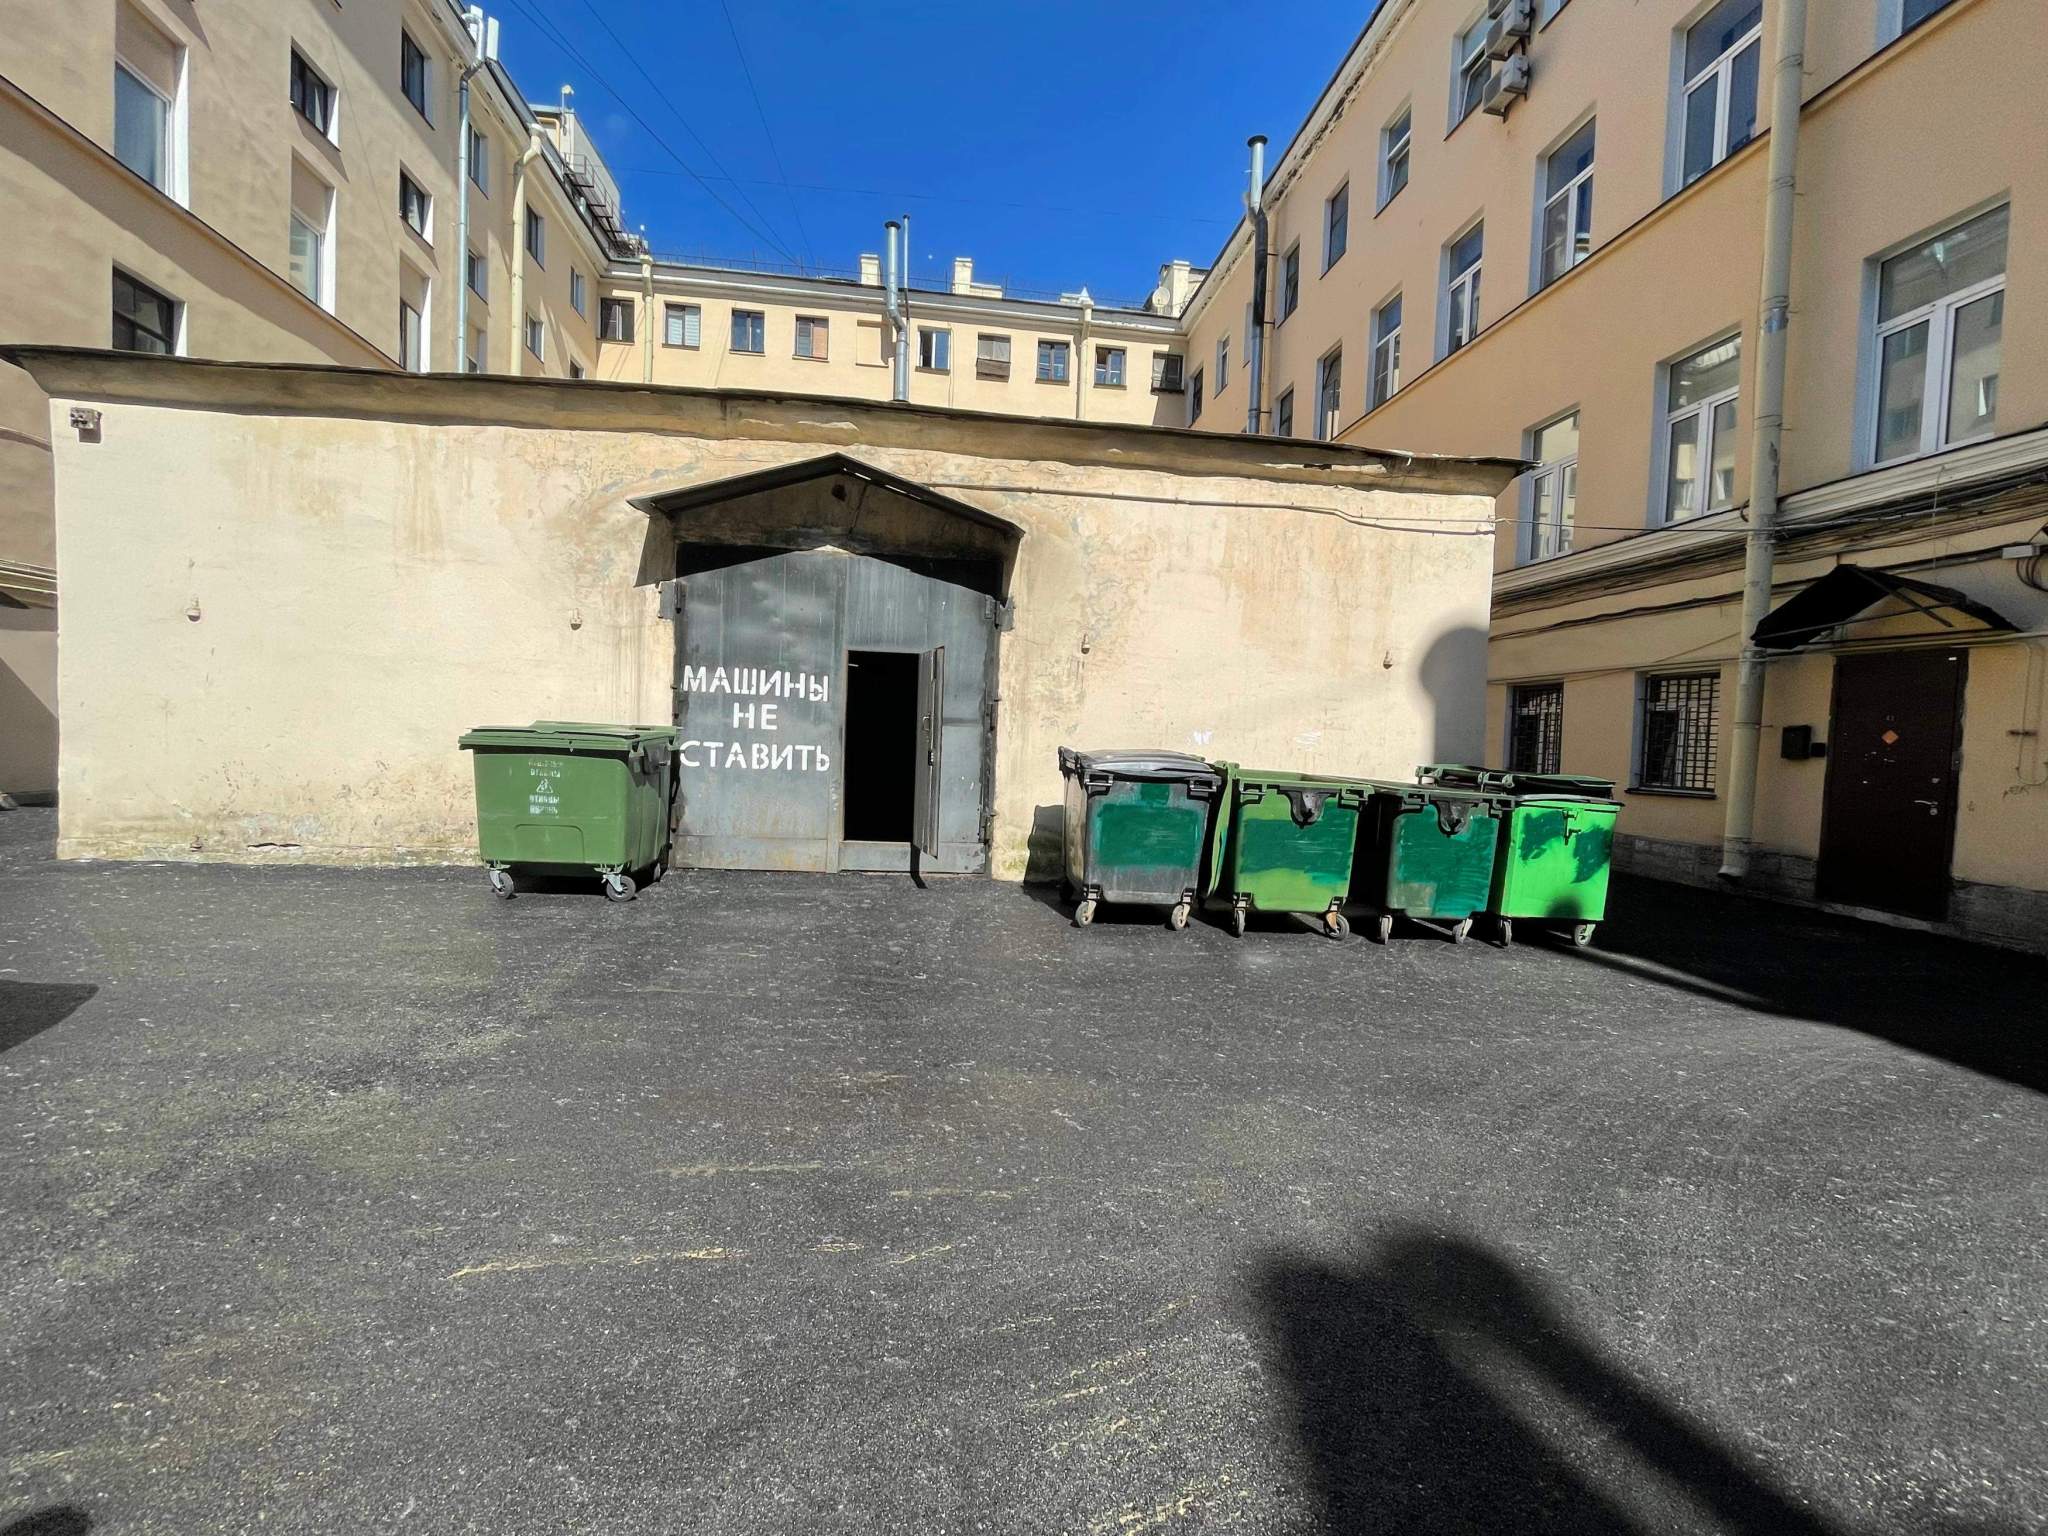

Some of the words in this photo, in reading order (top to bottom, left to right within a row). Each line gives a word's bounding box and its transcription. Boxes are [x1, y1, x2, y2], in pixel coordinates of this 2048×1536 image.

[682, 665, 829, 702] МАШИНЫ
[733, 702, 778, 730] НЕ
[679, 740, 831, 772] СТАВИТЬ
